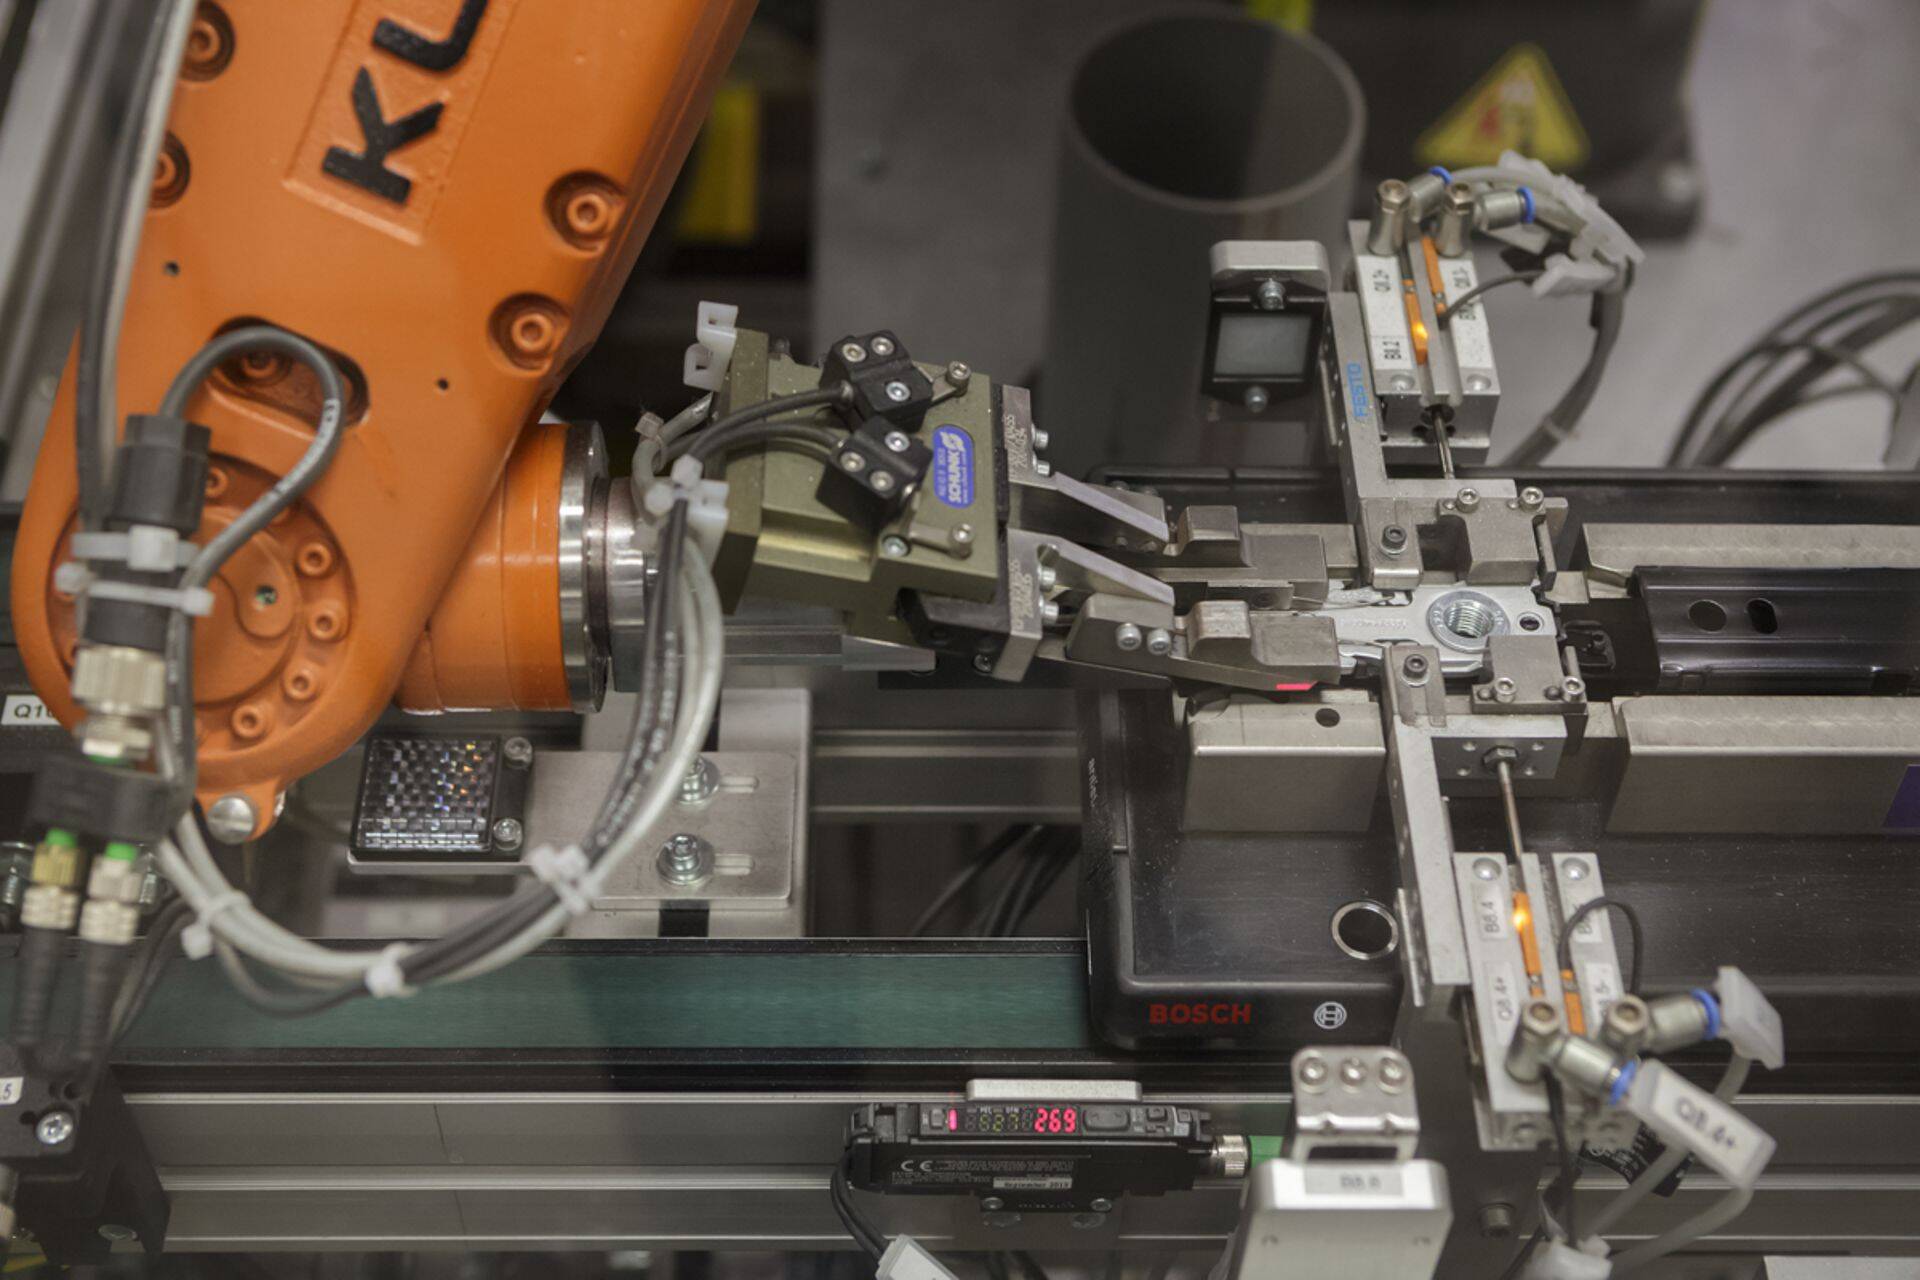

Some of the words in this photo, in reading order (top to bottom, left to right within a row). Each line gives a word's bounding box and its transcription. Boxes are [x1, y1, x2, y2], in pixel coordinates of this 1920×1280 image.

[1347, 363, 1368, 418] FESTO
[947, 450, 961, 503] SCHUNK
[1150, 1003, 1252, 1025] BOSCH
[1034, 1107, 1077, 1133] 269
